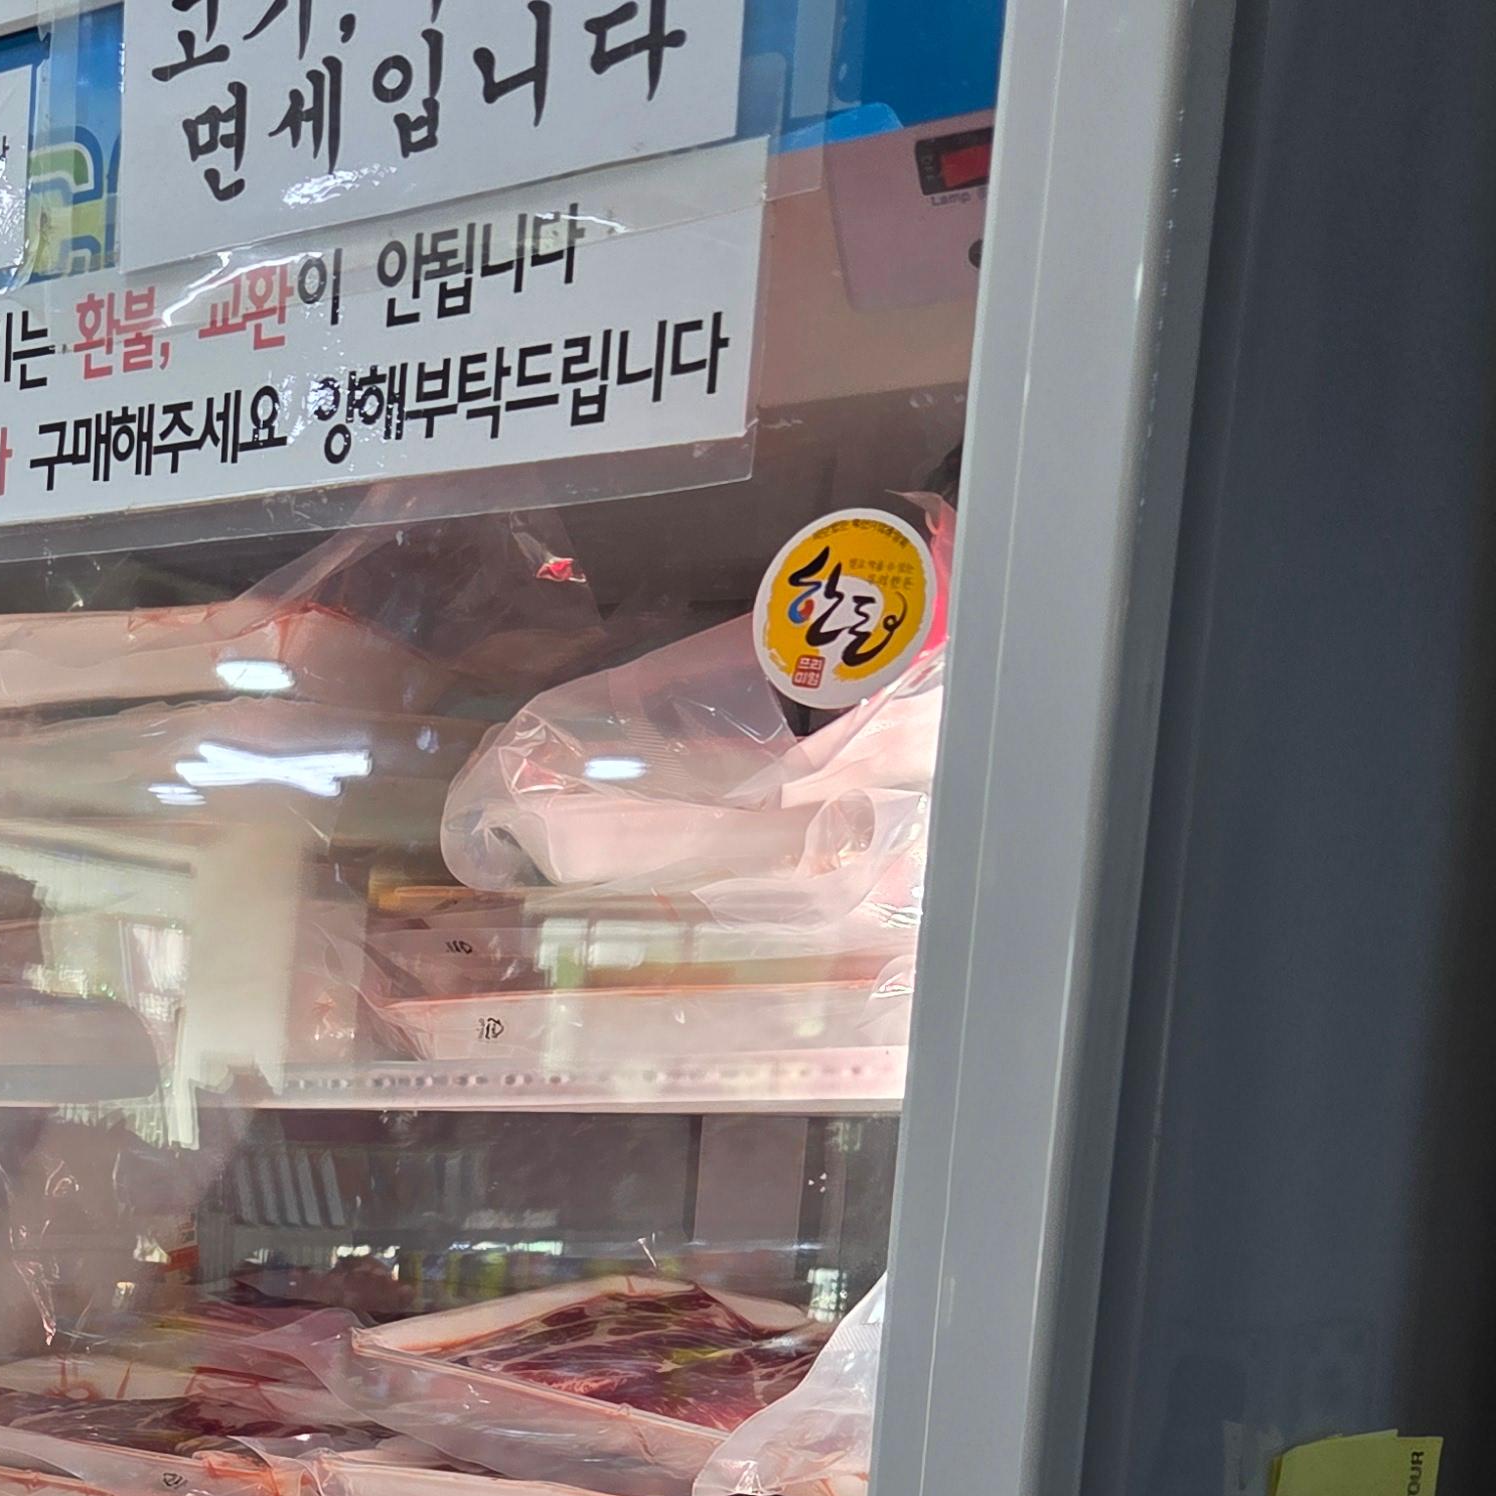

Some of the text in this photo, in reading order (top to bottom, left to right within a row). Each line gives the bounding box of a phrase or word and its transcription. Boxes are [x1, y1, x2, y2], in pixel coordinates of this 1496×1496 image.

[73, 284, 173, 378] 환불,
[199, 247, 341, 350] 교환이
[376, 204, 586, 327] 안됩니다
[29, 385, 287, 490] 구매해주세요
[310, 311, 729, 464] 양해부탁드립니다
